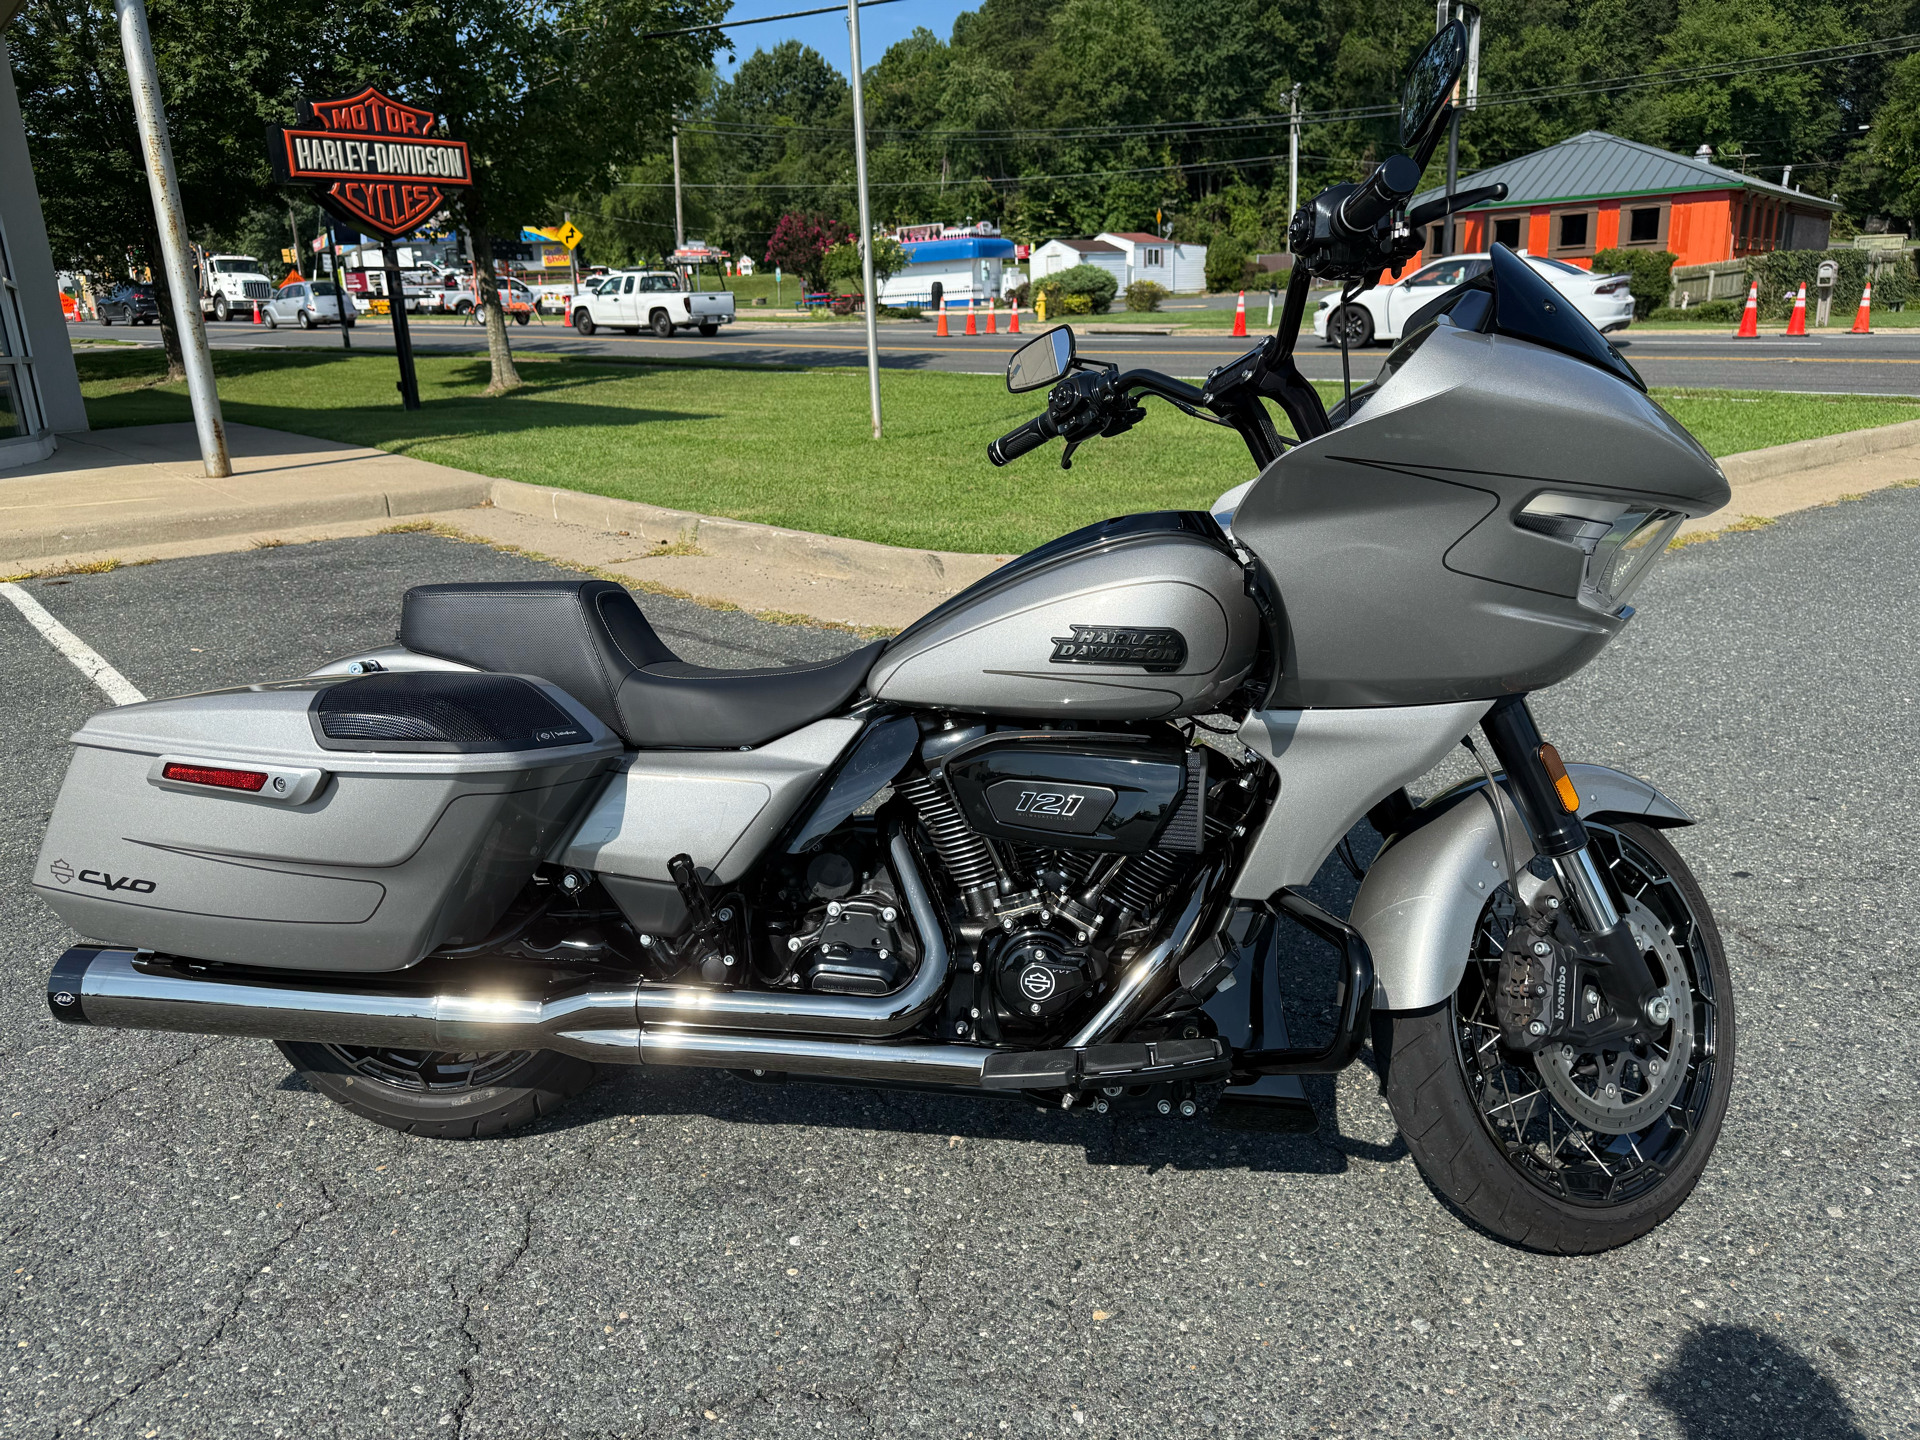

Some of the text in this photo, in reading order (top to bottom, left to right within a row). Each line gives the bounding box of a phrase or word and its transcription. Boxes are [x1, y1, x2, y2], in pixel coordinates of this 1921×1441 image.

[332, 97, 421, 135] MOTOR
[295, 138, 464, 177] HARLEY-DAVIDSON
[345, 182, 430, 225] CYCLES
[1059, 644, 1180, 661] DAVIDSON
[1015, 791, 1085, 816] 121
[78, 869, 157, 894] CVO
[1554, 965, 1567, 1020] brembo
